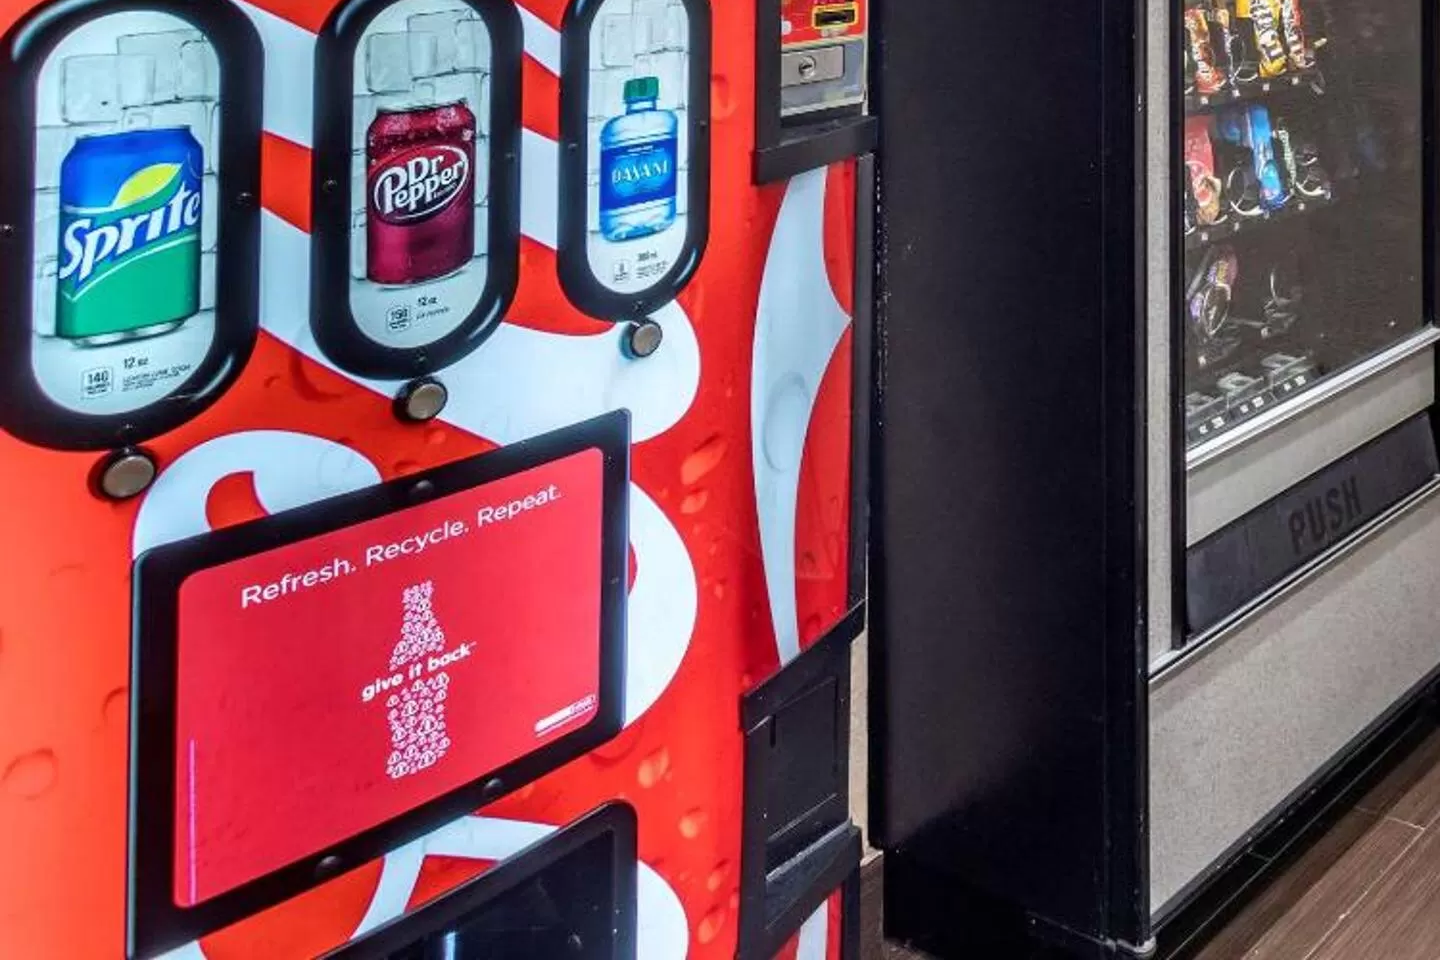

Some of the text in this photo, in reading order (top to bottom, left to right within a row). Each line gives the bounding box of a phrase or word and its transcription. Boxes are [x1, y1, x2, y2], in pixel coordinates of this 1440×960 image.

[383, 160, 465, 215] Pepper
[407, 154, 444, 187] Dr
[58, 181, 200, 283] Sprite
[87, 369, 109, 385] 140
[123, 356, 136, 369] 12
[1287, 474, 1363, 556] PUSH
[240, 557, 357, 609] Refresh.
[365, 520, 470, 567] Recycle.
[361, 672, 405, 703] give
[408, 661, 423, 680] it
